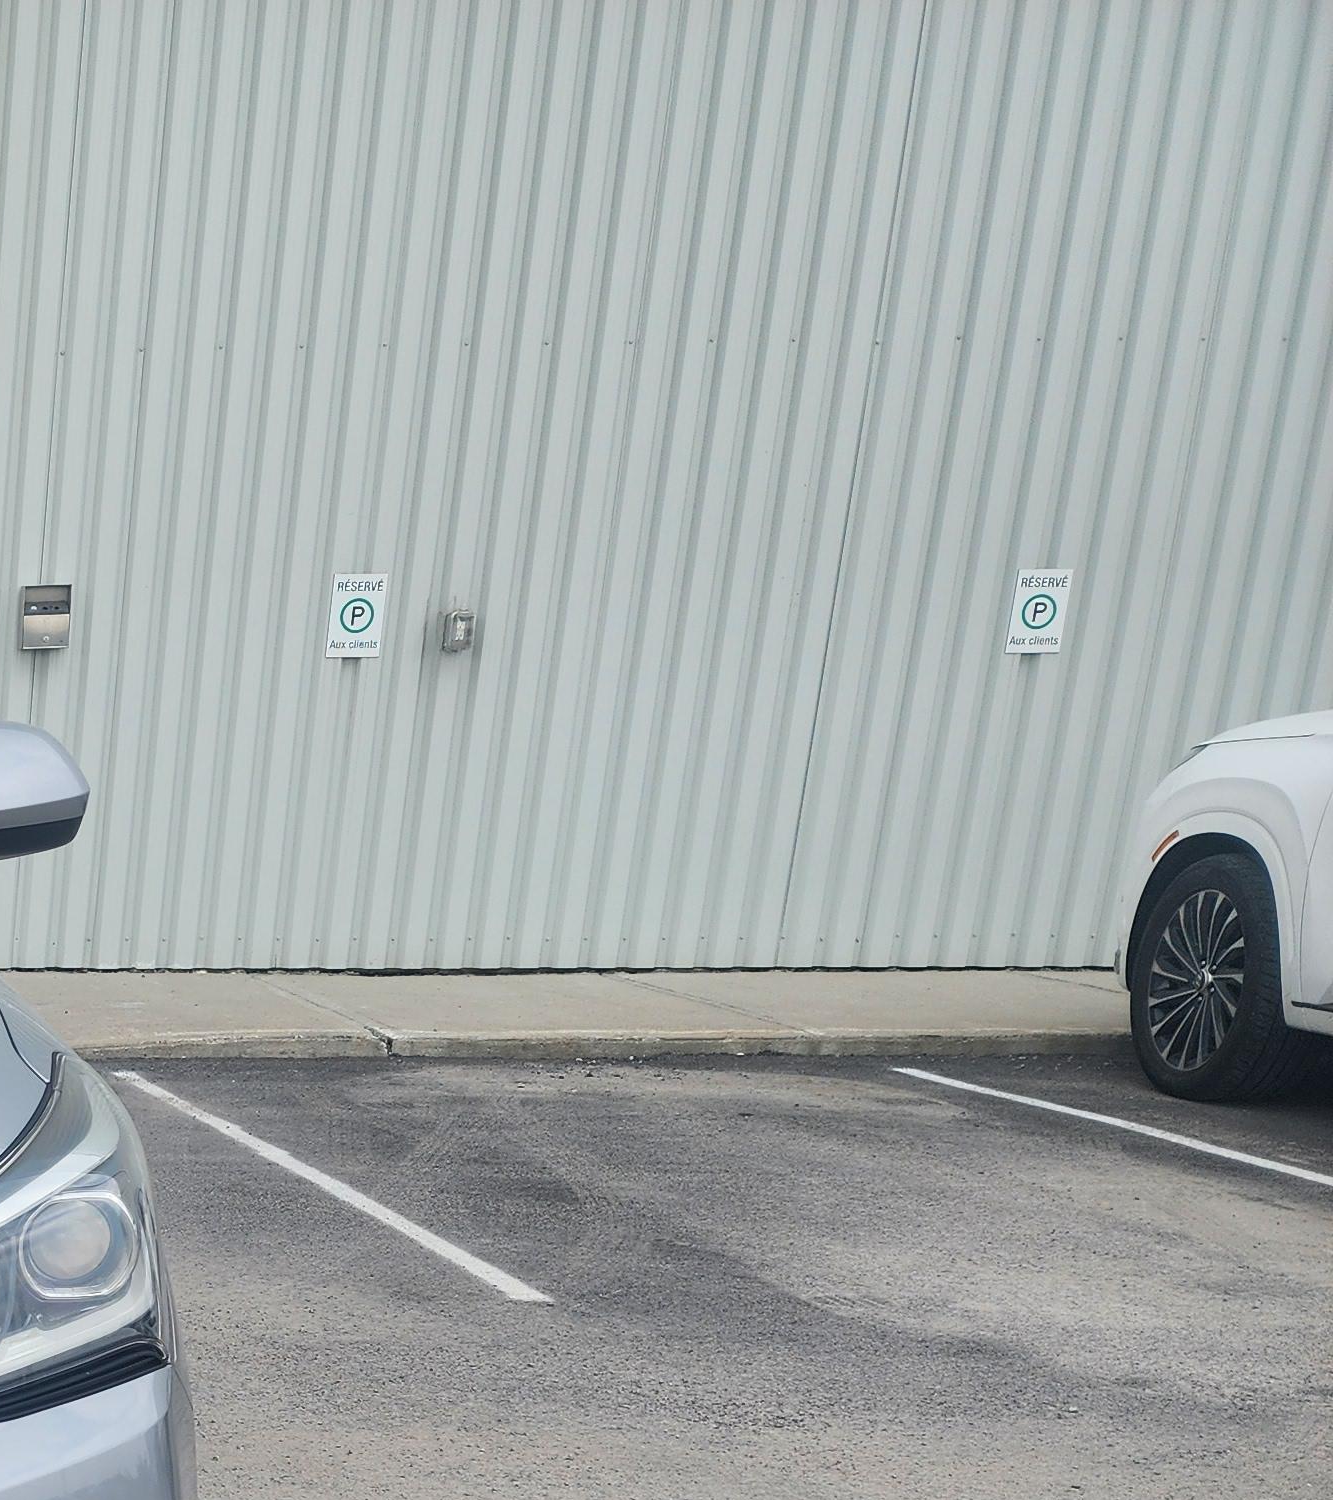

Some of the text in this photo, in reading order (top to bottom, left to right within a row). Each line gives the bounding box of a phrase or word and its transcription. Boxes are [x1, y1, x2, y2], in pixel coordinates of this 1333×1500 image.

[337, 579, 384, 592] RÉSERVÉ
[1020, 575, 1069, 588] RÉSERVÉ
[350, 606, 365, 626] P
[1031, 602, 1048, 622] P
[329, 639, 378, 649] Aux clients
[1009, 635, 1059, 646] Aux clients
